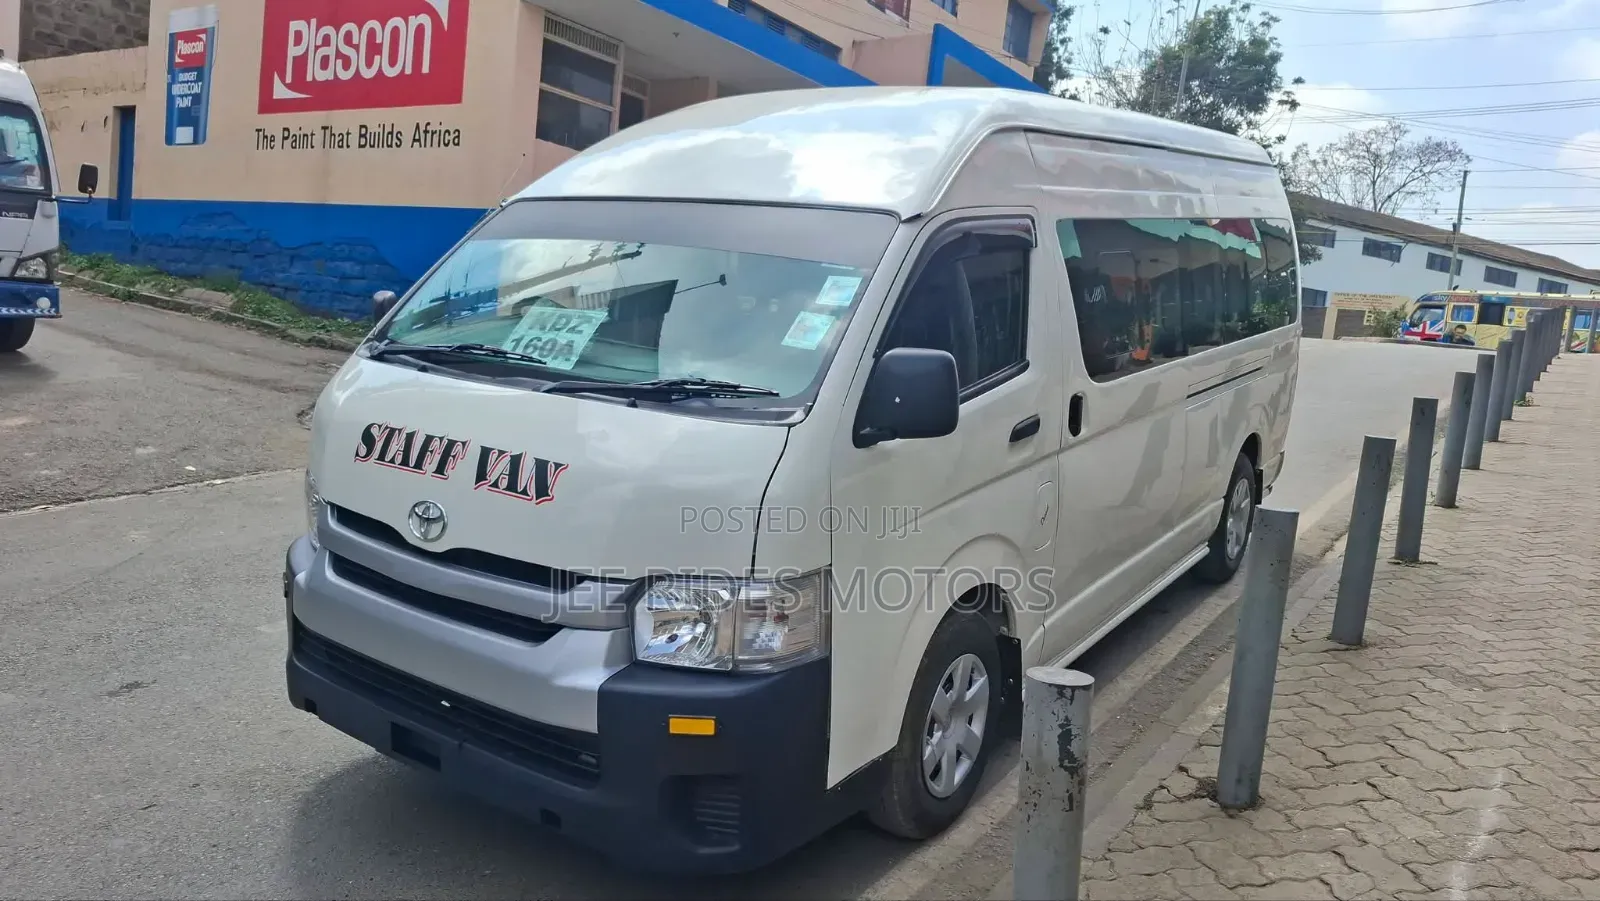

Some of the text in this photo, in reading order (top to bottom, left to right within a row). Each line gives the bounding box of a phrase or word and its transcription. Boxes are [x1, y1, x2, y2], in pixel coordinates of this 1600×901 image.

[177, 40, 204, 55] Plascon
[285, 13, 432, 84] Plascon
[178, 72, 197, 82] BUDGET
[172, 82, 202, 95] UNDERCOAT
[175, 97, 192, 108] PAINT
[255, 121, 461, 151] The Paint That Builds Africa
[354, 420, 569, 505] STAFF VAN
